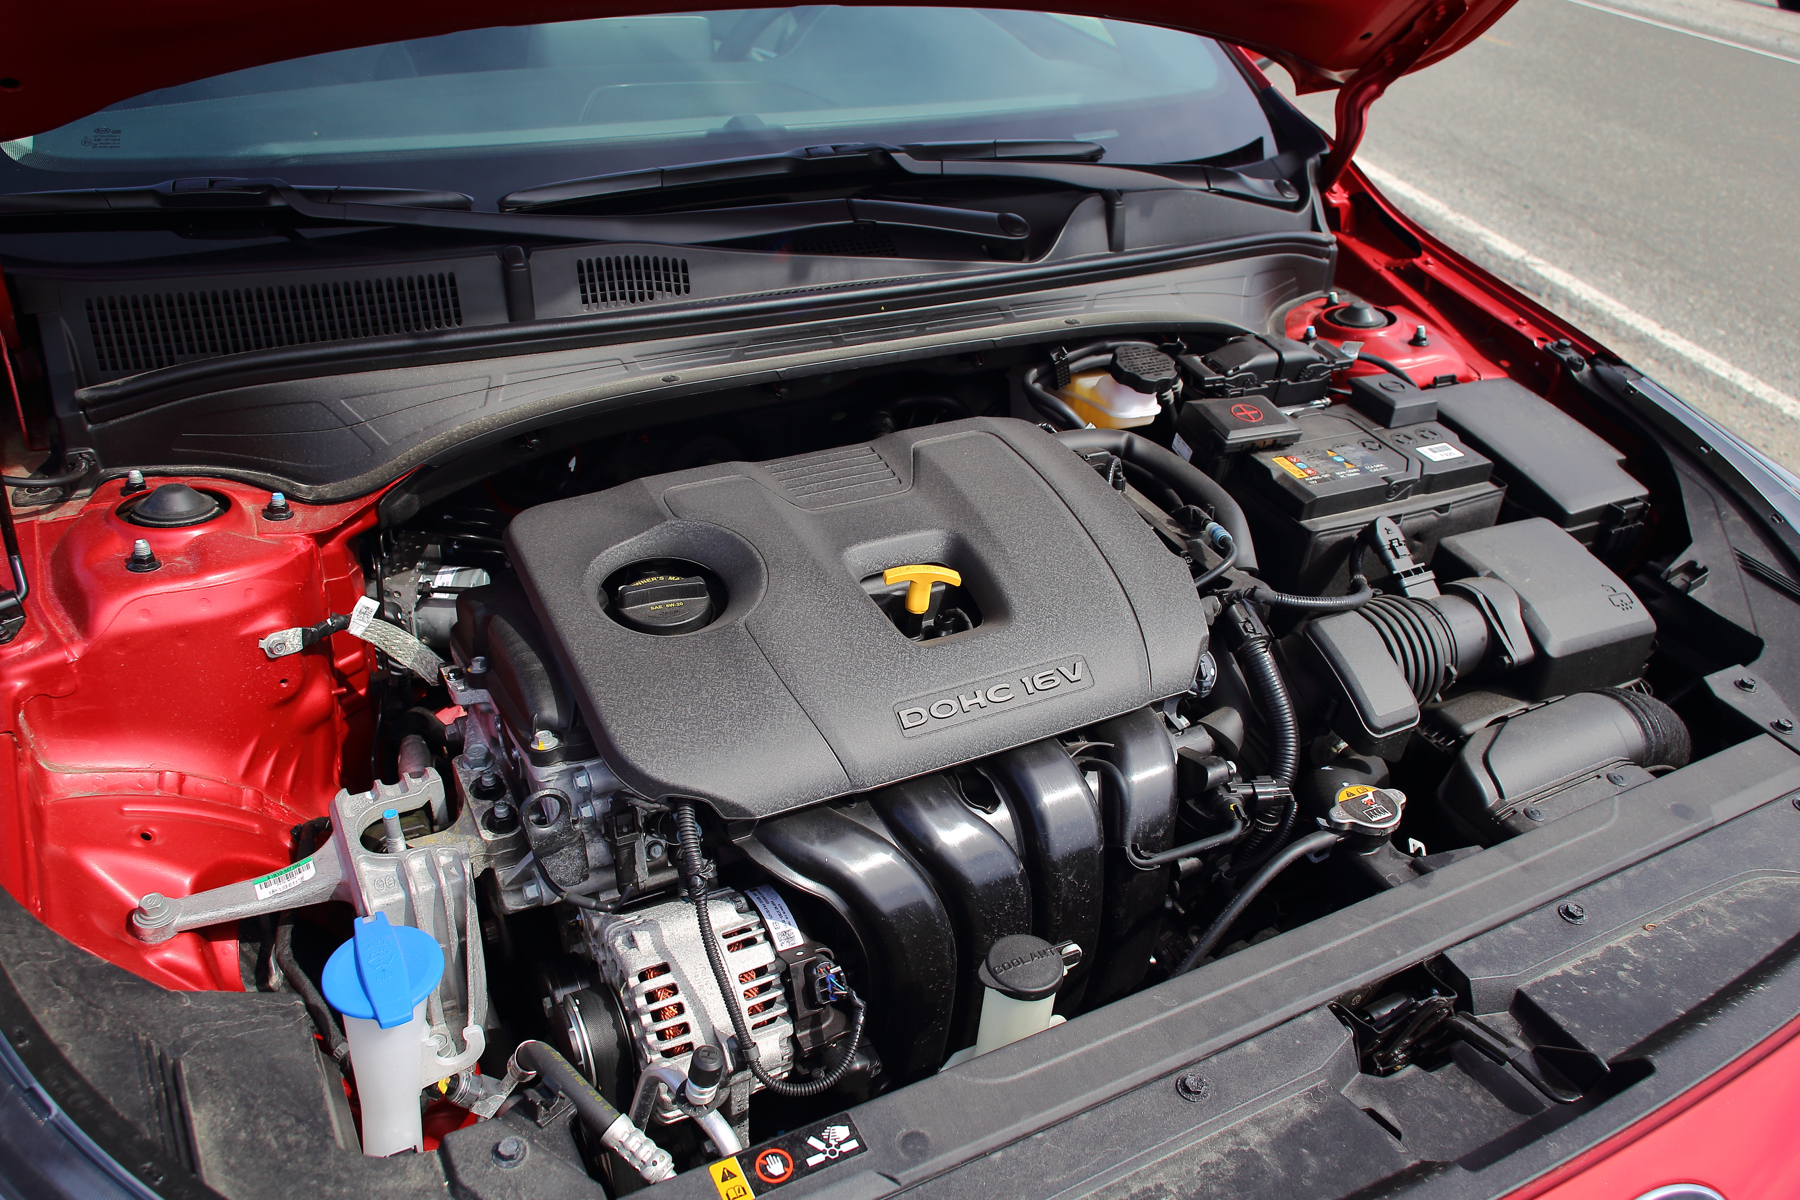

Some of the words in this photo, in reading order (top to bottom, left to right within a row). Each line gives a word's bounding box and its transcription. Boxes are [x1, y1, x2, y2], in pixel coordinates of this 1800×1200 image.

[898, 683, 1015, 730] DOHC
[1020, 661, 1082, 696] 16V
[993, 948, 1057, 975] COOLANT
